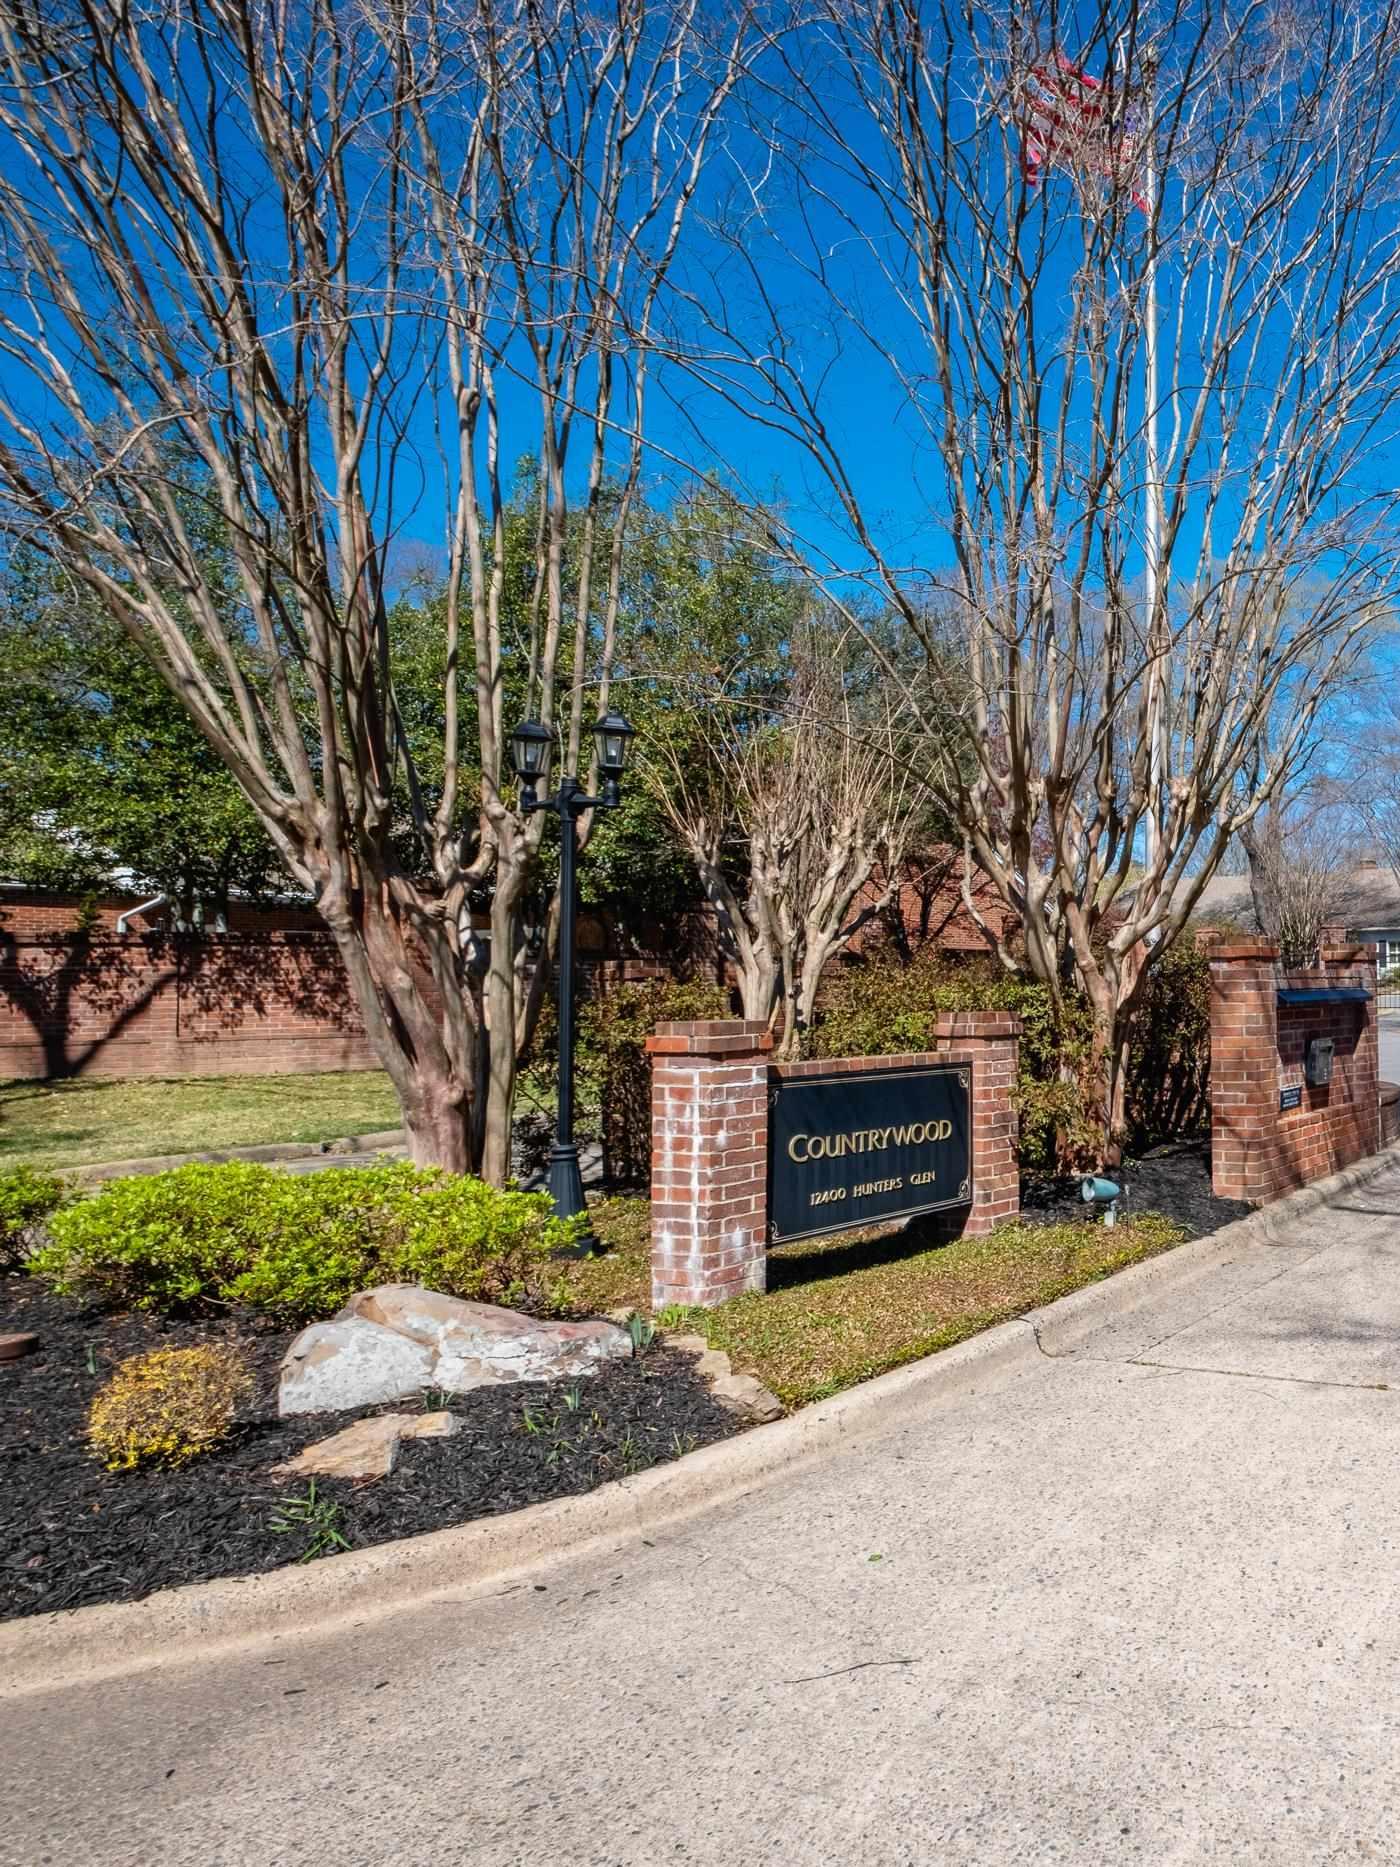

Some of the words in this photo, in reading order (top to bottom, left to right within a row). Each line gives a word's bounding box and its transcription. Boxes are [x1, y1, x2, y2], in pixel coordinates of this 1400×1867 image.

[788, 1119, 953, 1162] COUNTRYWOOD
[810, 1188, 846, 1206] 12400
[853, 1177, 903, 1197] HUNTERS
[910, 1170, 936, 1185] GLEN
